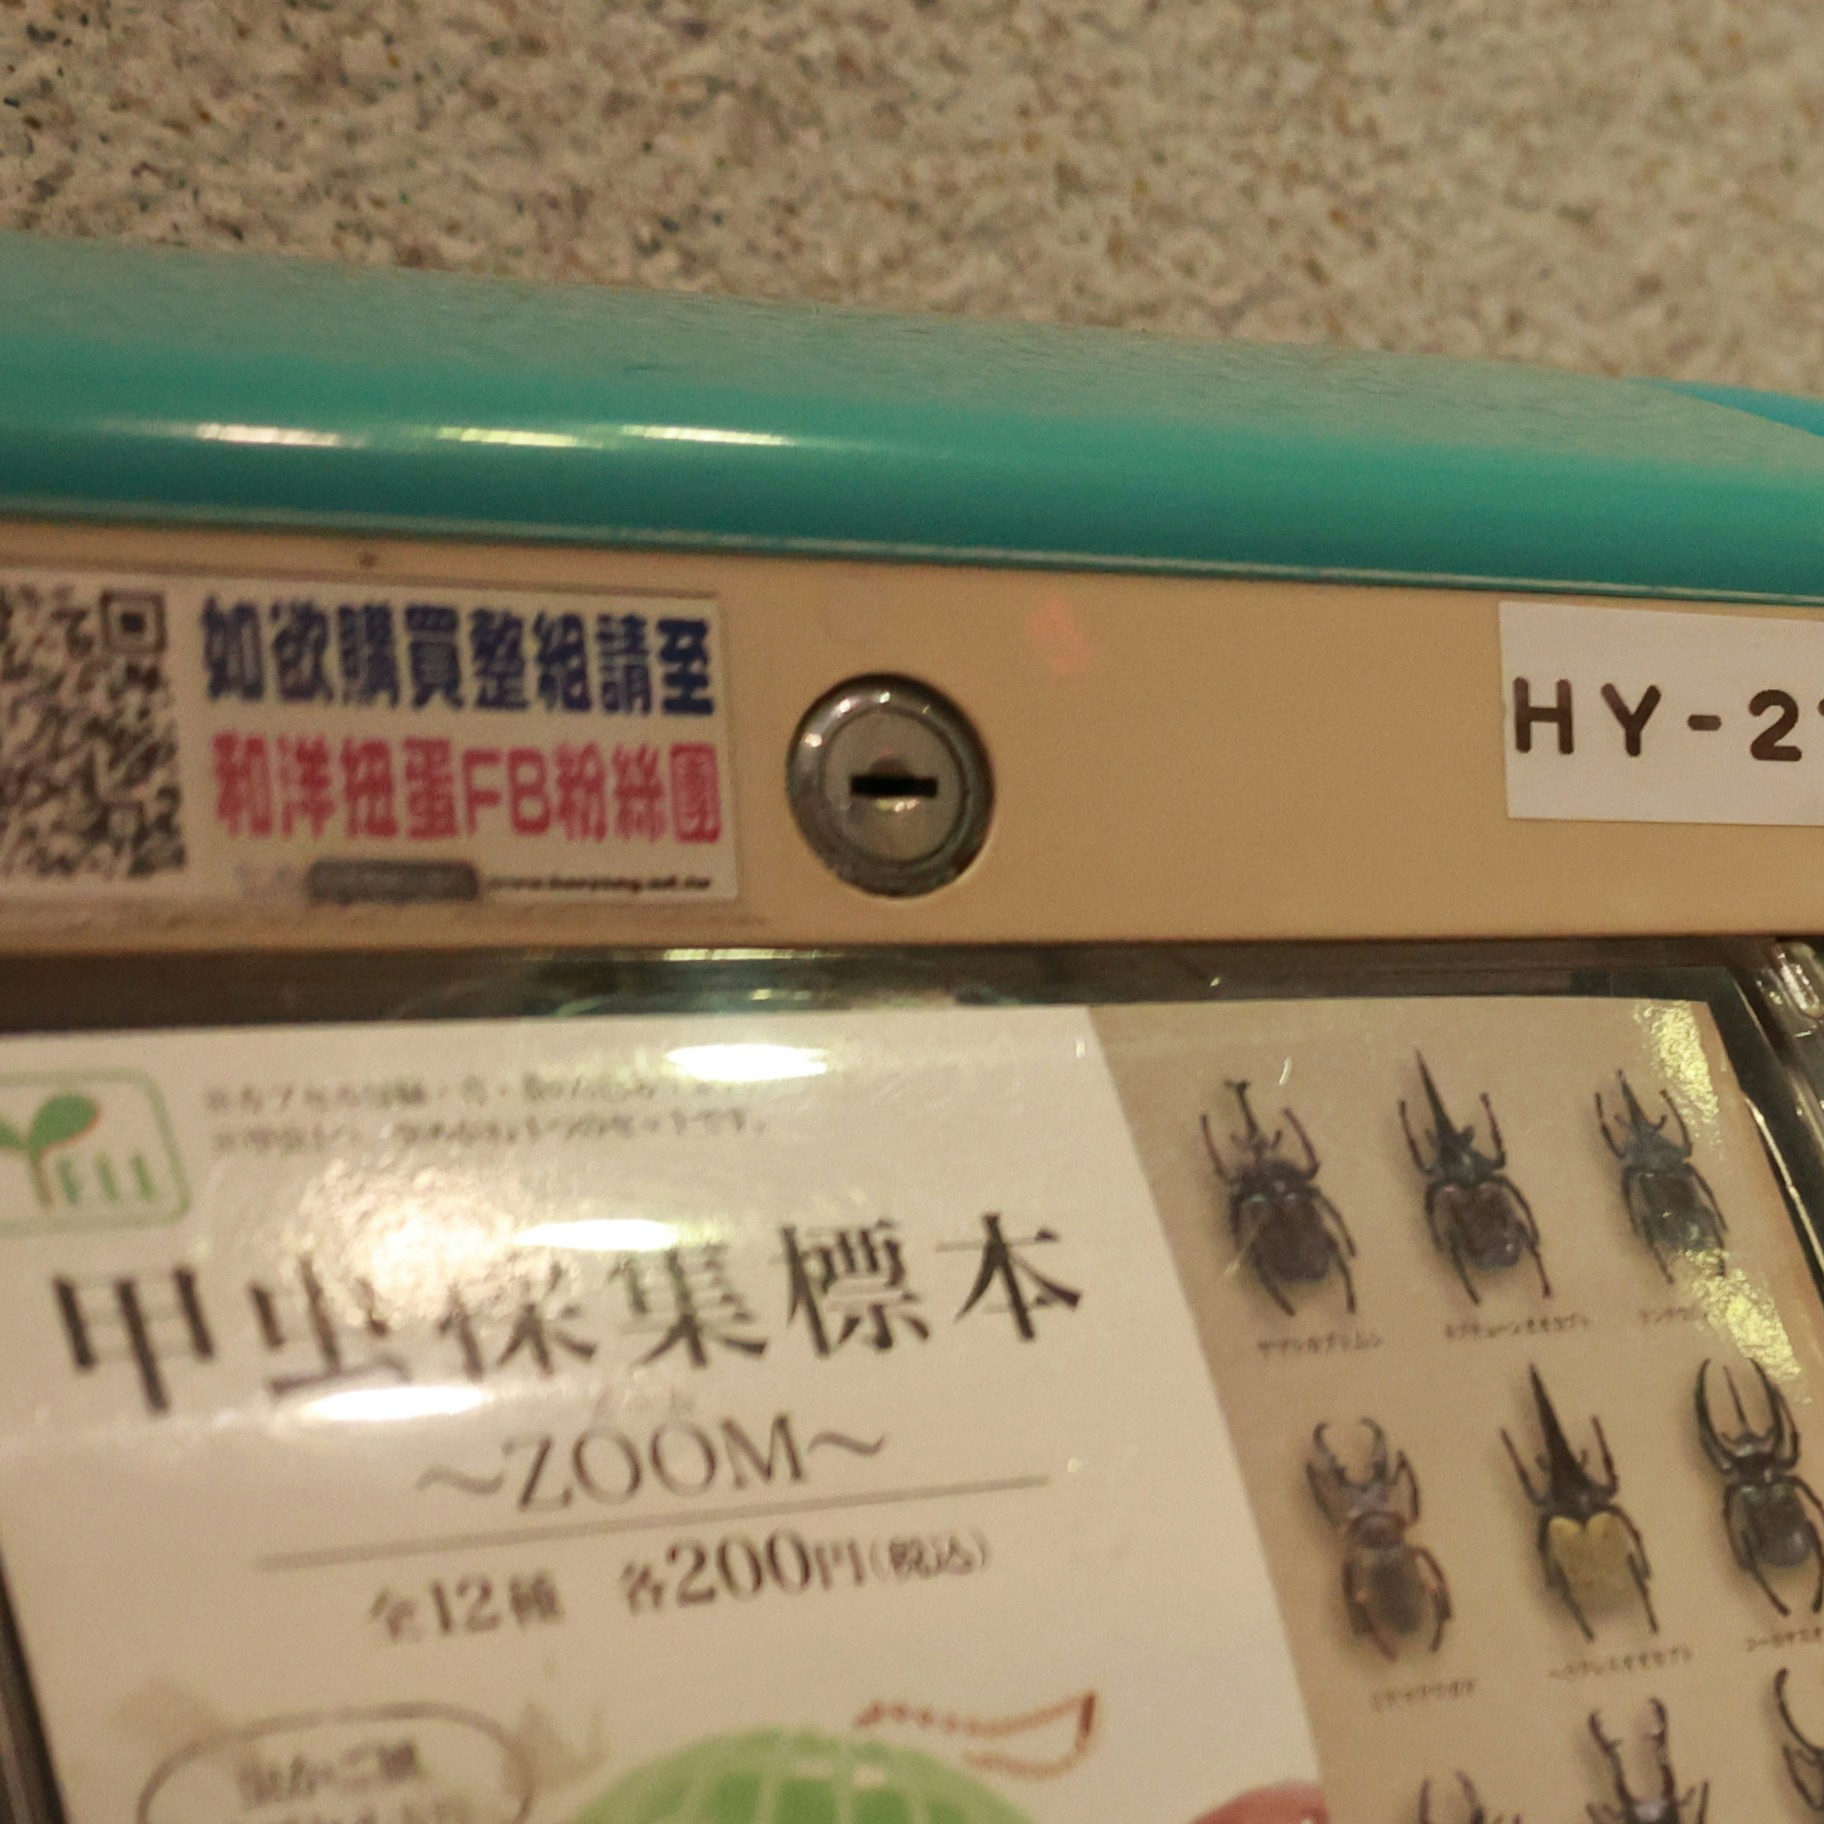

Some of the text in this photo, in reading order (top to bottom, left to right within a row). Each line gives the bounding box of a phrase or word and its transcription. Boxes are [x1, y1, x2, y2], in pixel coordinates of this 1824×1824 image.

[202, 594, 716, 717] 如欲購買整組請至
[211, 728, 722, 845] 和洋扭蛋FB粉絲團
